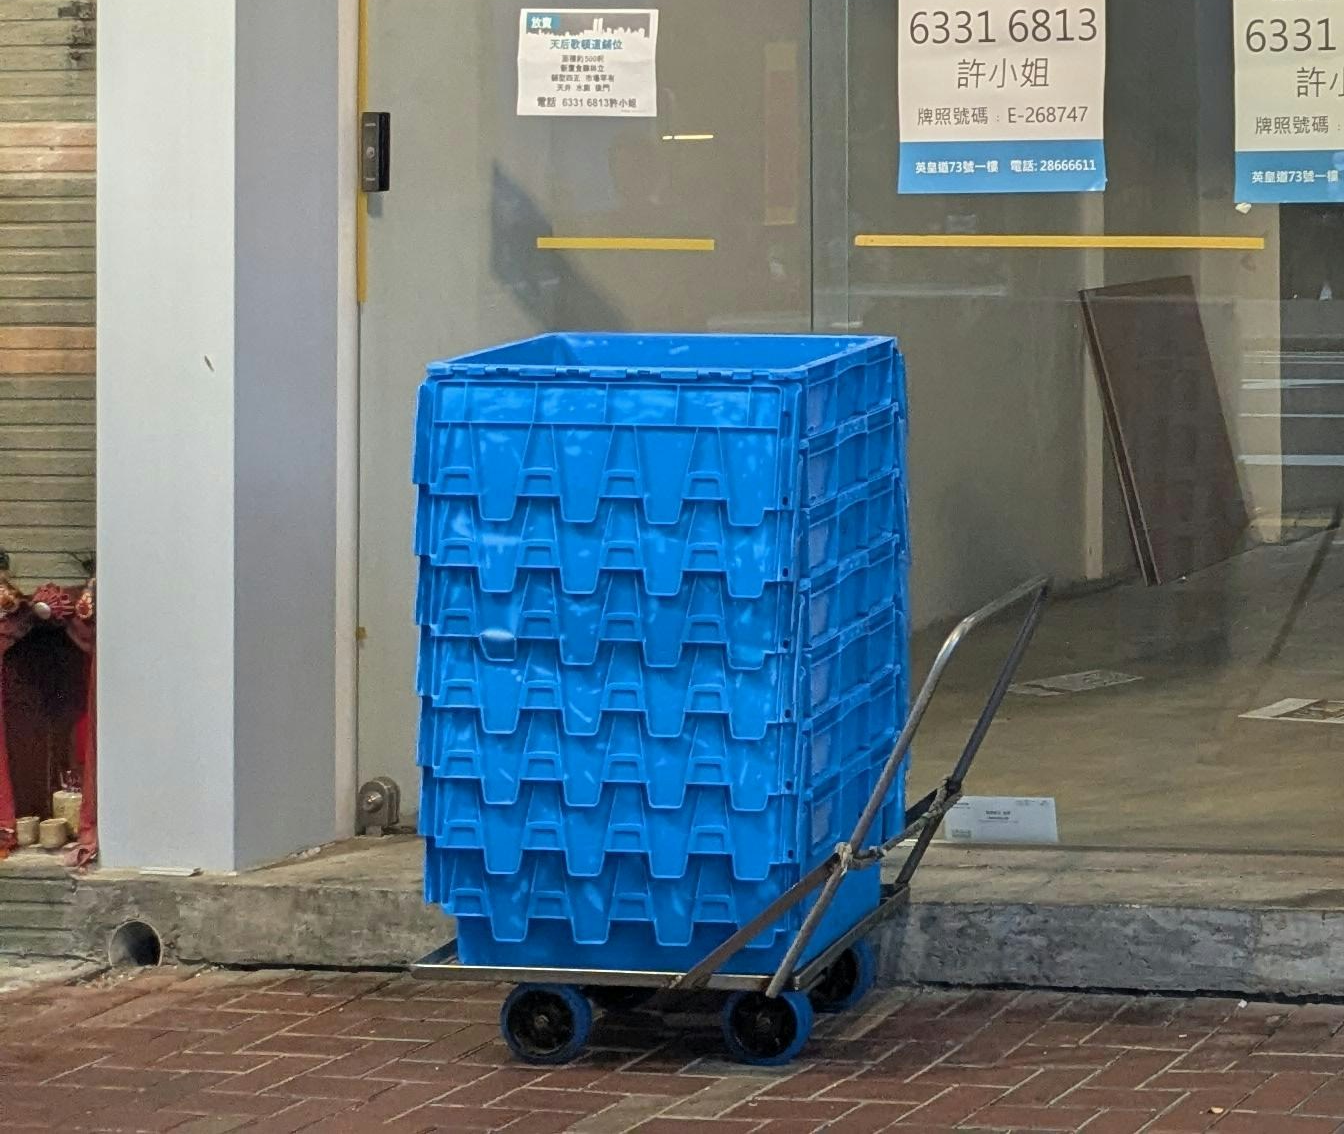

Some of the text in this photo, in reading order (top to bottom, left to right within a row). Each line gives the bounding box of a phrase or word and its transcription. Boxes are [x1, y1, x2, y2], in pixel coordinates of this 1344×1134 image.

[910, 8, 1097, 44] 6331 6813
[1246, 18, 1336, 52] 6331
[957, 57, 1049, 89] 許小姐
[562, 98, 583, 107] 6331
[1007, 106, 1088, 123] E-268747
[1040, 159, 1097, 171] 28666611
